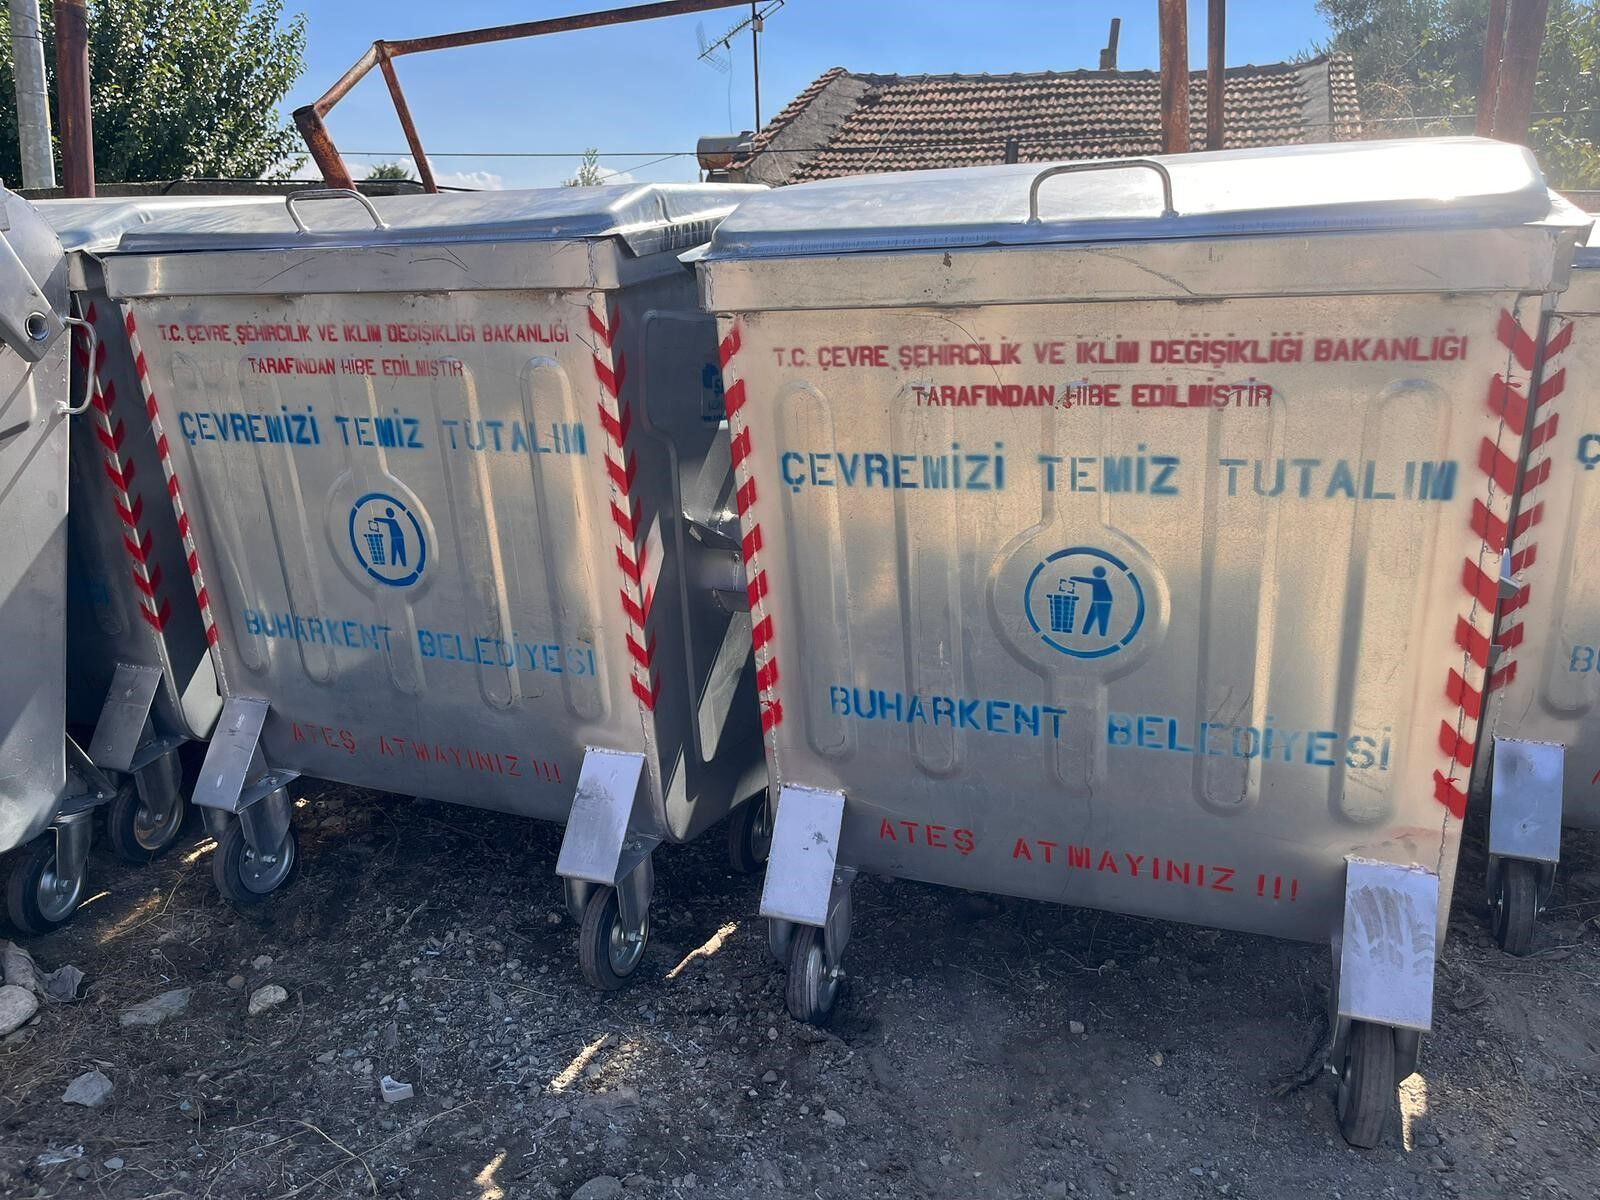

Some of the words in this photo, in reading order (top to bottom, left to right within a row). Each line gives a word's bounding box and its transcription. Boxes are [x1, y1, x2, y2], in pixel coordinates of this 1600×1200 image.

[318, 324, 339, 342] VE
[772, 347, 811, 367] T.C.
[899, 337, 1022, 371] ŞEHİRCİLİK
[1033, 342, 1066, 365] VE
[1313, 328, 1468, 364] BAKANLIĞI
[248, 357, 336, 375] TARAFINDAN
[911, 385, 1055, 407] TARAFINDAN
[1131, 377, 1273, 411] EDİLMİŞTİR
[178, 405, 321, 445] ÇEVREMİZİ
[335, 407, 424, 449] TEMİZ
[442, 419, 588, 455] TUTALIM
[781, 441, 1005, 493] ÇEVREMİZİ
[1037, 443, 1181, 496] TEMİZ
[1219, 457, 1458, 501] TUTALIM
[243, 609, 393, 650] BUHARKENT
[416, 629, 596, 677] BELEDİYESİ
[291, 721, 357, 755] ATEŞ
[379, 735, 522, 778] ATMAYINIZ
[829, 685, 1068, 739] BUHARKENT
[1106, 714, 1392, 771] BELEDİYESİ
[879, 817, 976, 856] ATEŞ
[1012, 837, 1236, 893] ATMAYINIZ
[1256, 873, 1299, 903] !!!
